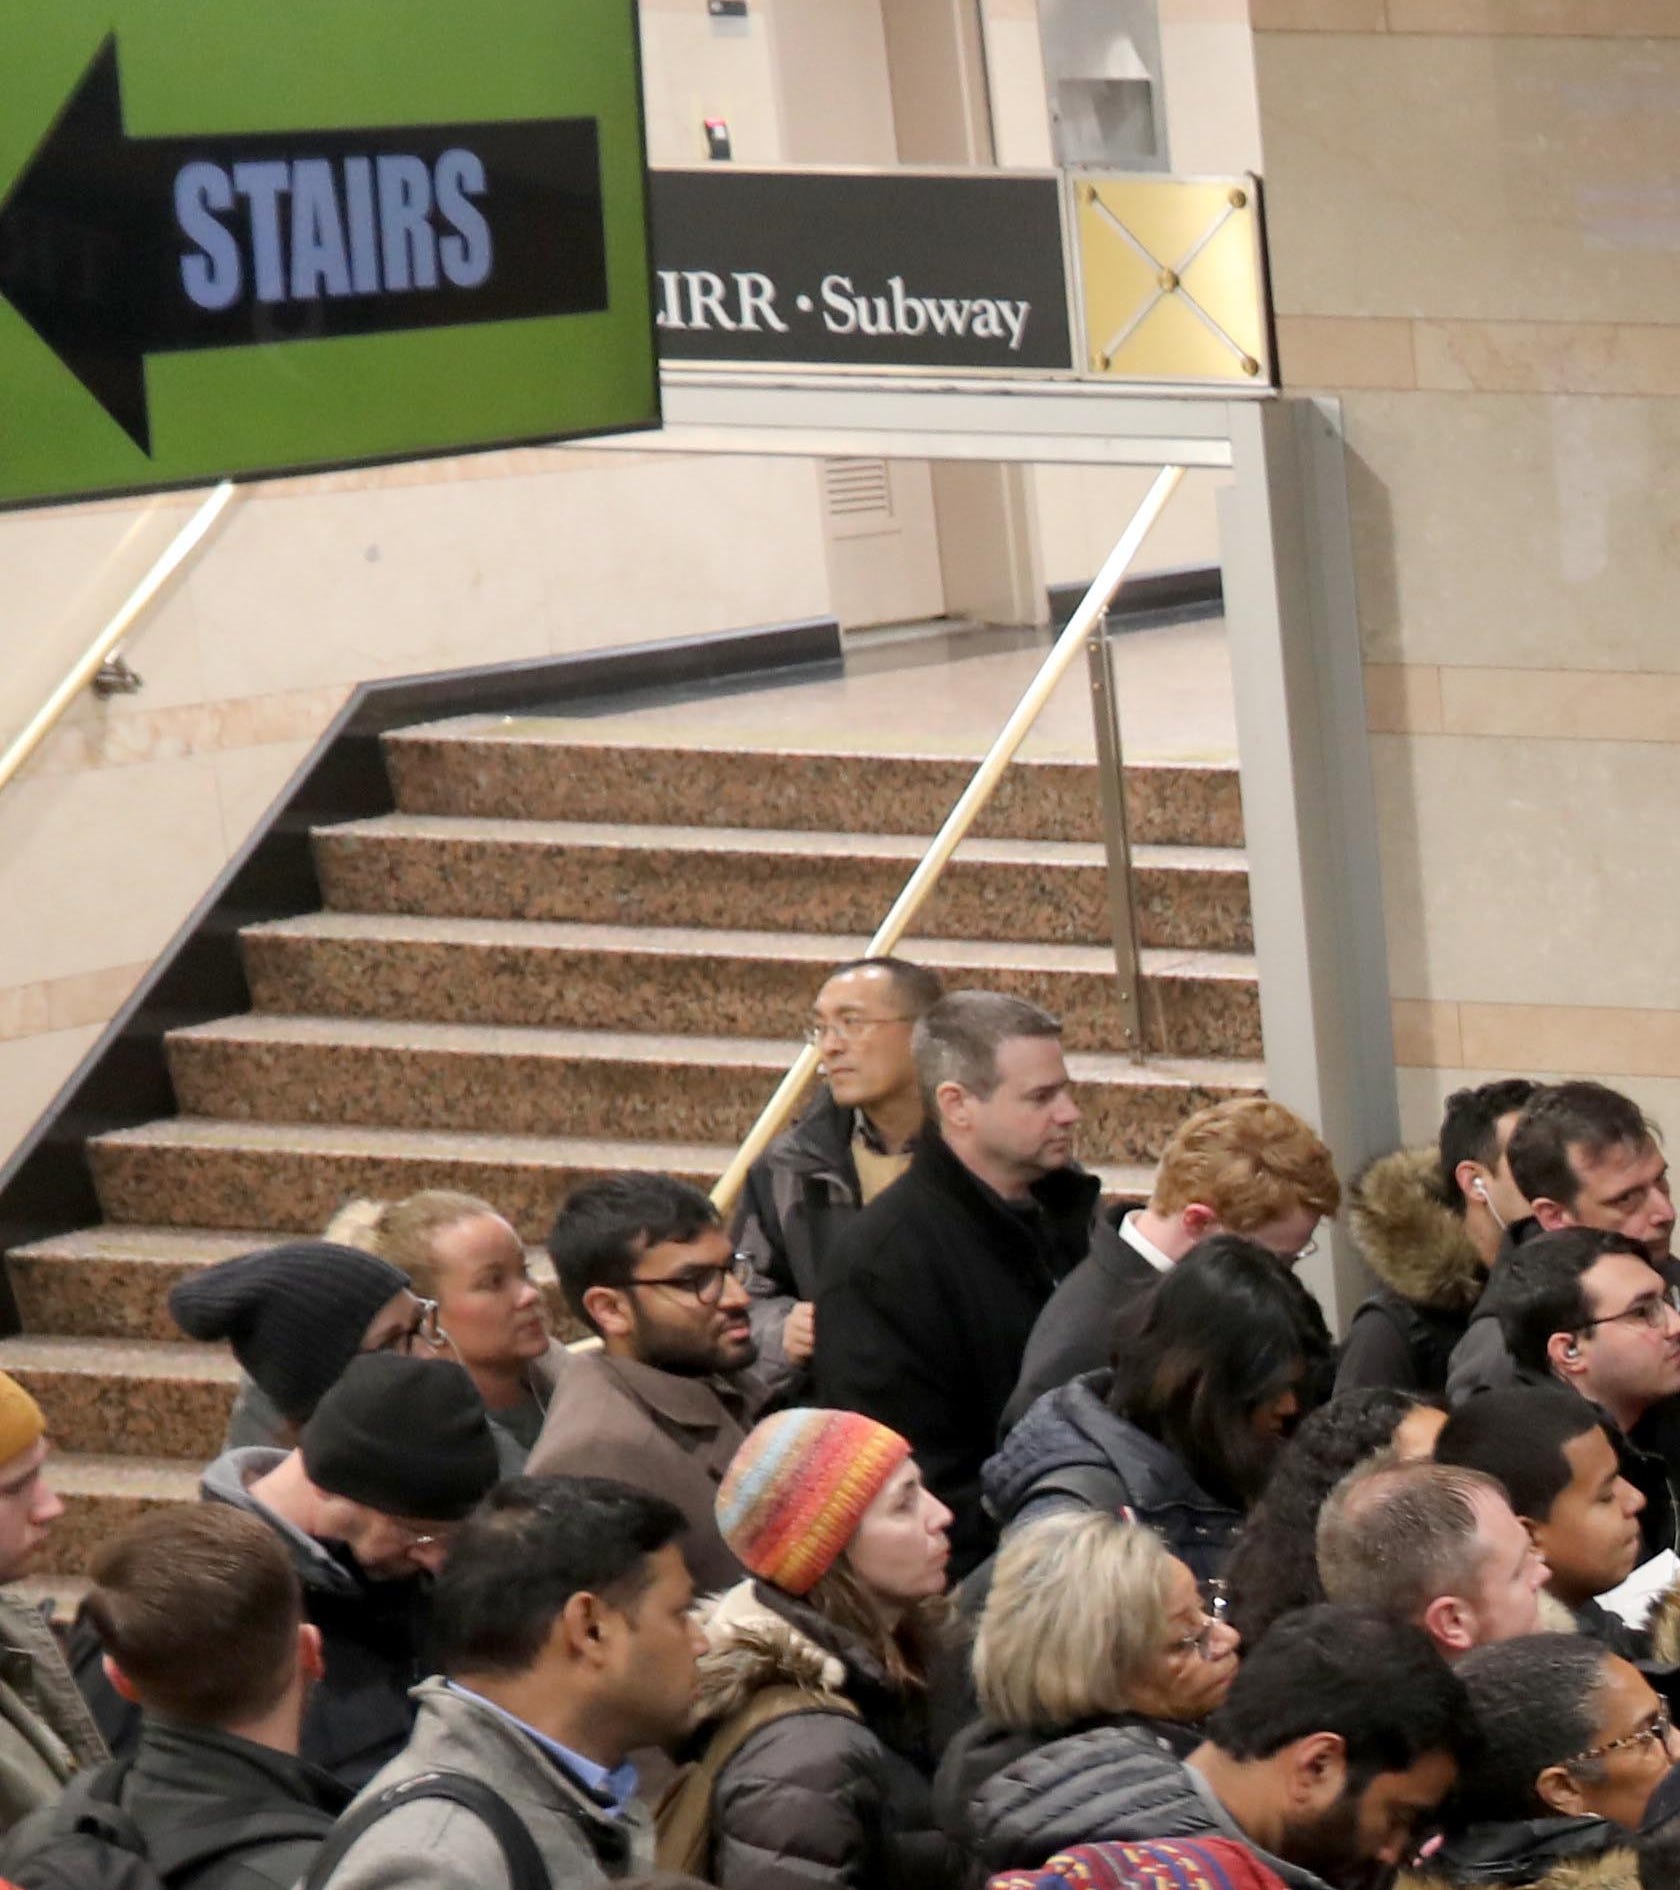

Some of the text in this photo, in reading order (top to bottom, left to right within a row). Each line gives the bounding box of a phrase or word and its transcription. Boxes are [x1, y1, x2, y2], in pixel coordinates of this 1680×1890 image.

[174, 148, 492, 311] STAIRS
[656, 270, 1031, 351] IRR Subway
